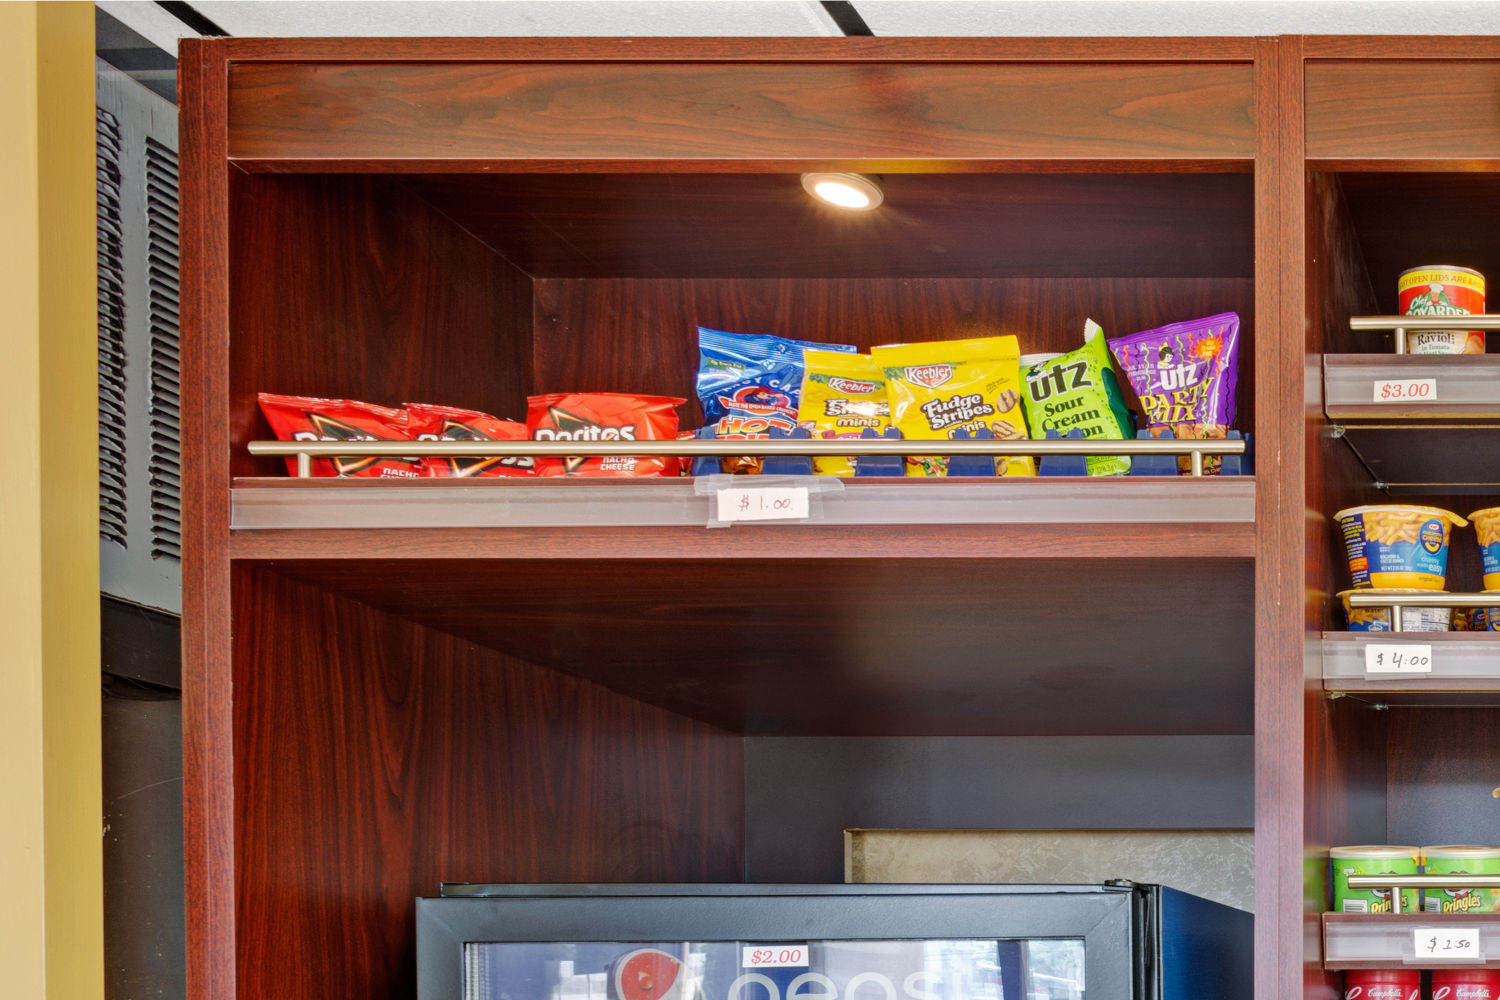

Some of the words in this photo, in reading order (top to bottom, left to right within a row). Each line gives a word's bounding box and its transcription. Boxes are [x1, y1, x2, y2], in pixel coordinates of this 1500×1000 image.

[1411, 295, 1428, 309] Chef
[829, 378, 876, 394] Keebler
[905, 365, 953, 389] Keebler
[1139, 377, 1214, 415] PARTY
[1381, 382, 1430, 399] $3.00
[924, 394, 982, 418] Fudge
[930, 403, 994, 430] Stripes
[1045, 395, 1084, 417] Sour
[837, 418, 880, 428] minis
[1042, 409, 1100, 433] Cream
[1443, 893, 1481, 913] Pringles
[751, 950, 801, 964] $2.00
